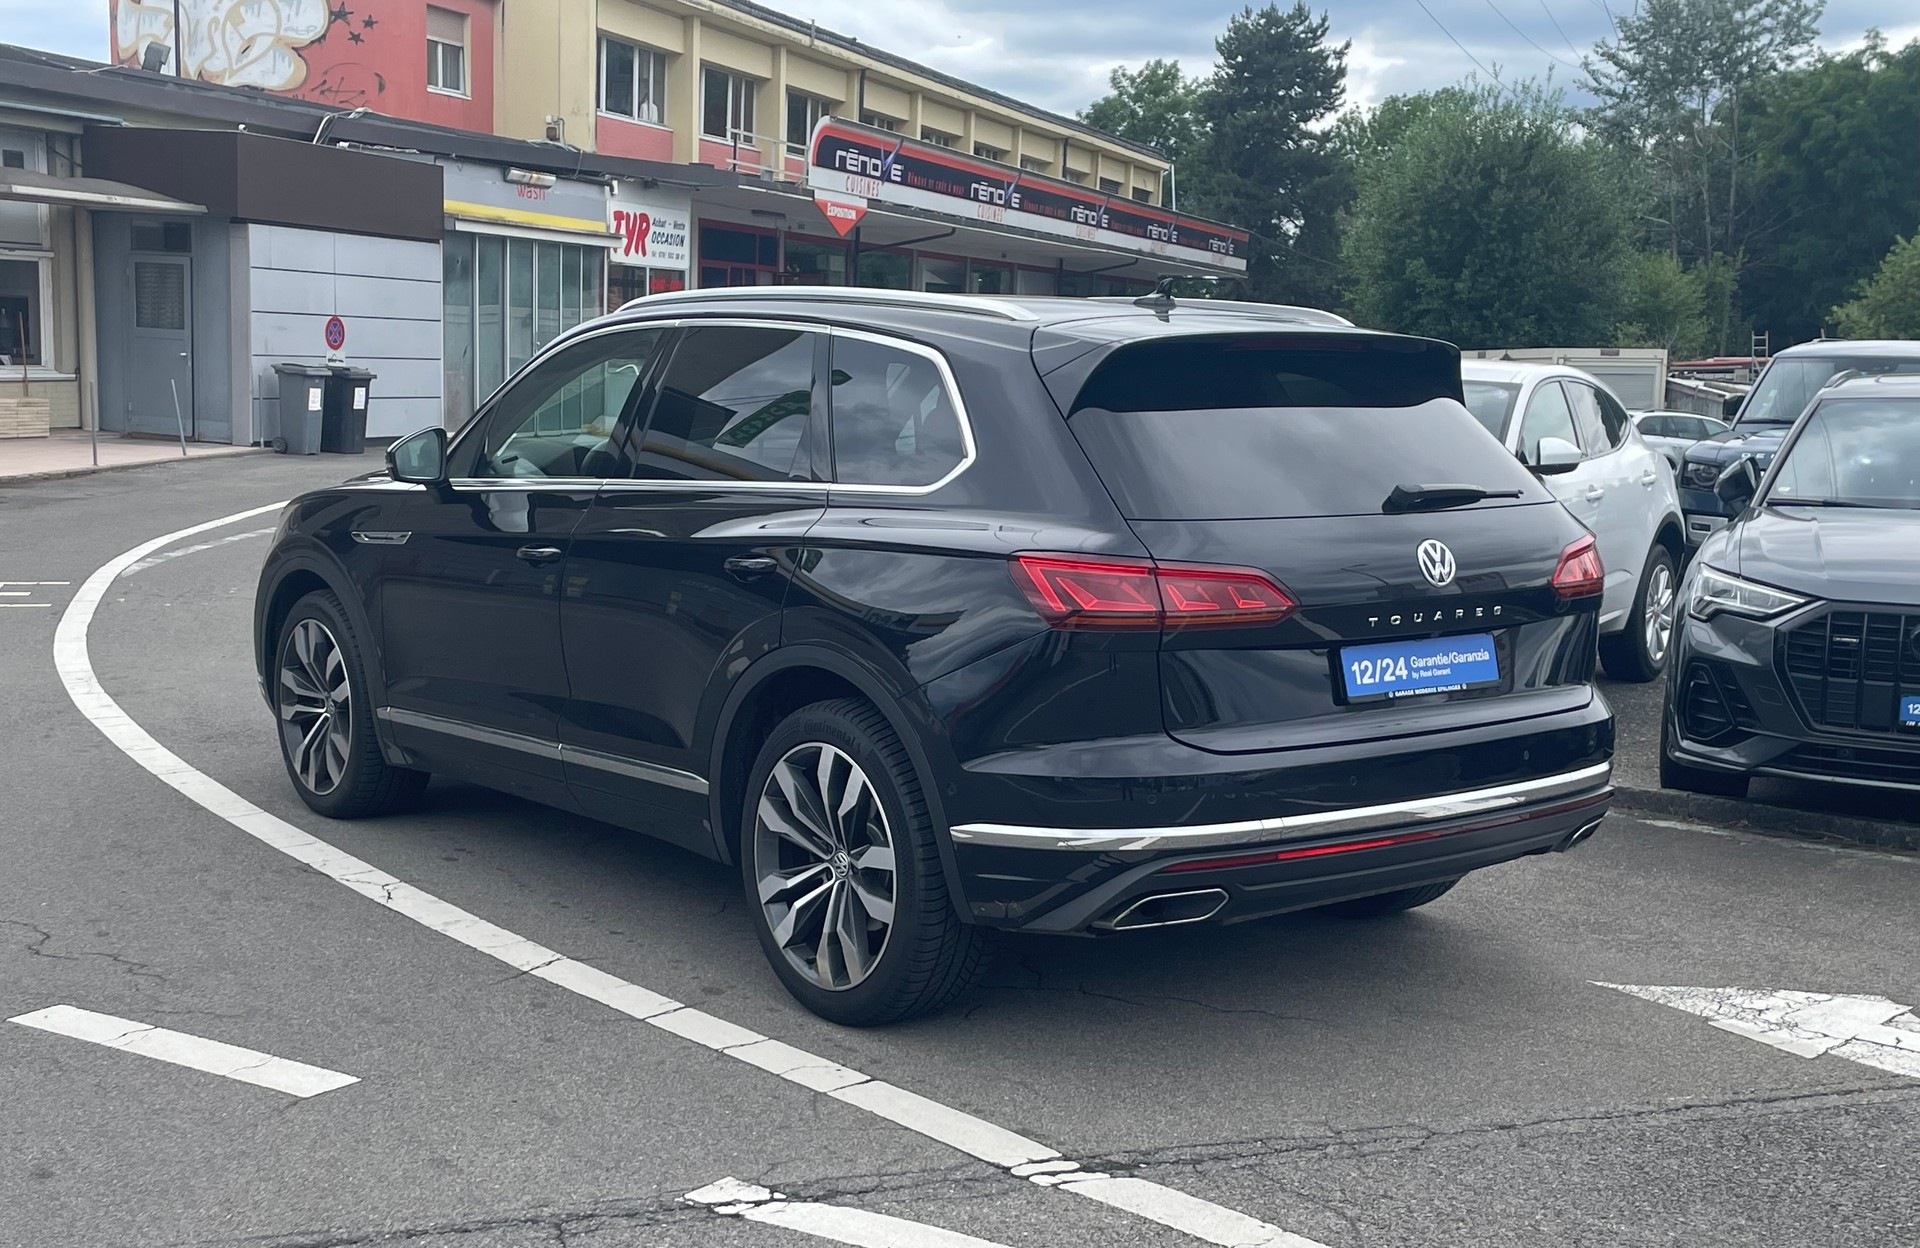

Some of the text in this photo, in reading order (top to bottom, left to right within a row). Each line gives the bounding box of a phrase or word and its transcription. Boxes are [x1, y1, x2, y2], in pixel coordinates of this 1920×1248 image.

[845, 175, 880, 198] CUISINES
[613, 210, 651, 257] TYR
[651, 231, 686, 247] OCCASION
[1368, 605, 1503, 628] TOUAREG
[1410, 648, 1490, 668] Garantie/Garanzia
[1351, 657, 1408, 685] 12/24
[1411, 667, 1452, 680] by Real Garant
[1394, 687, 1415, 698] GARAGE
[1415, 685, 1437, 695] MODERNE
